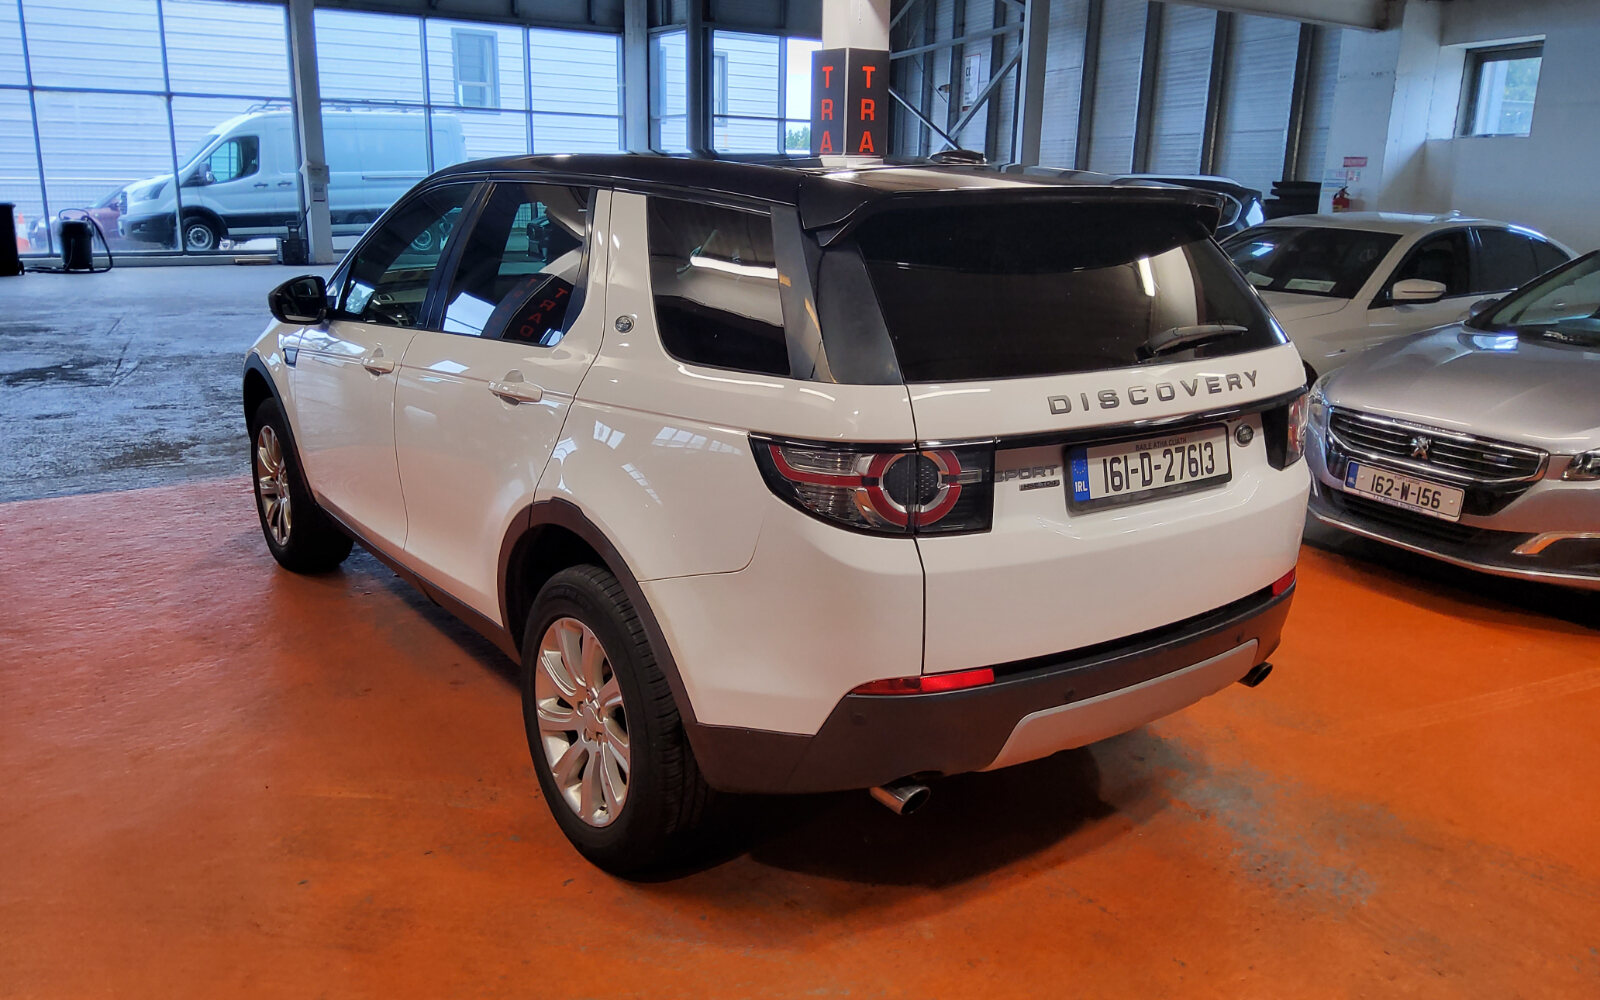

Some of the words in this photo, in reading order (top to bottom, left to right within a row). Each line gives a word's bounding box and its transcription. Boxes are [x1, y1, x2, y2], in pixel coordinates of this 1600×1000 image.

[858, 65, 876, 153] TRA
[1047, 370, 1258, 415] DISCOVERY
[994, 464, 1058, 483] SPORT
[1075, 480, 1088, 493] IRL
[1103, 441, 1216, 493] 161-D-27613
[1371, 473, 1442, 509] 162-W-156
